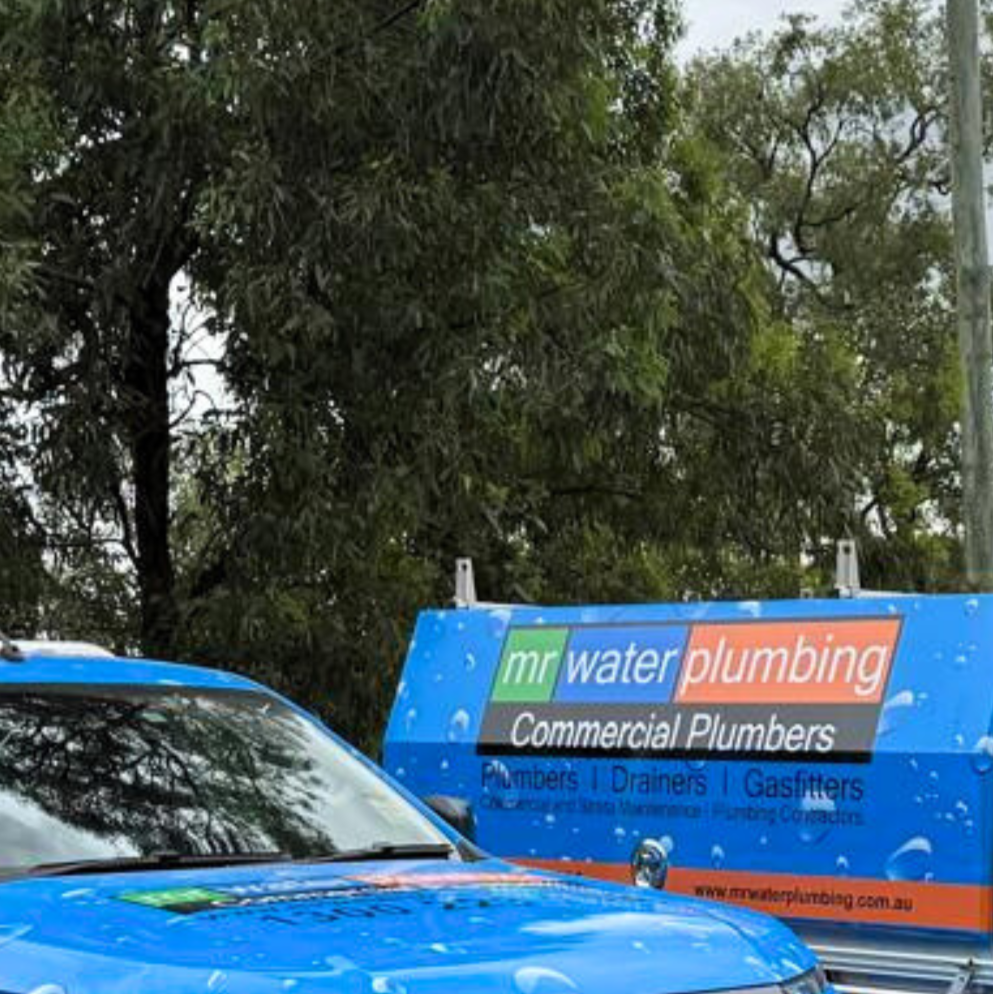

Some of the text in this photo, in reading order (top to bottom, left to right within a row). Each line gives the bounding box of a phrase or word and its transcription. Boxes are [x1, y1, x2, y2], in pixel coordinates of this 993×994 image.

[502, 633, 889, 697] mr water plumbing
[509, 711, 837, 753] Commercial Plumbers
[481, 760, 864, 801] Plumbers Drainers Gasfitters
[694, 881, 914, 913] www.mrwaterplumbing.com.au
